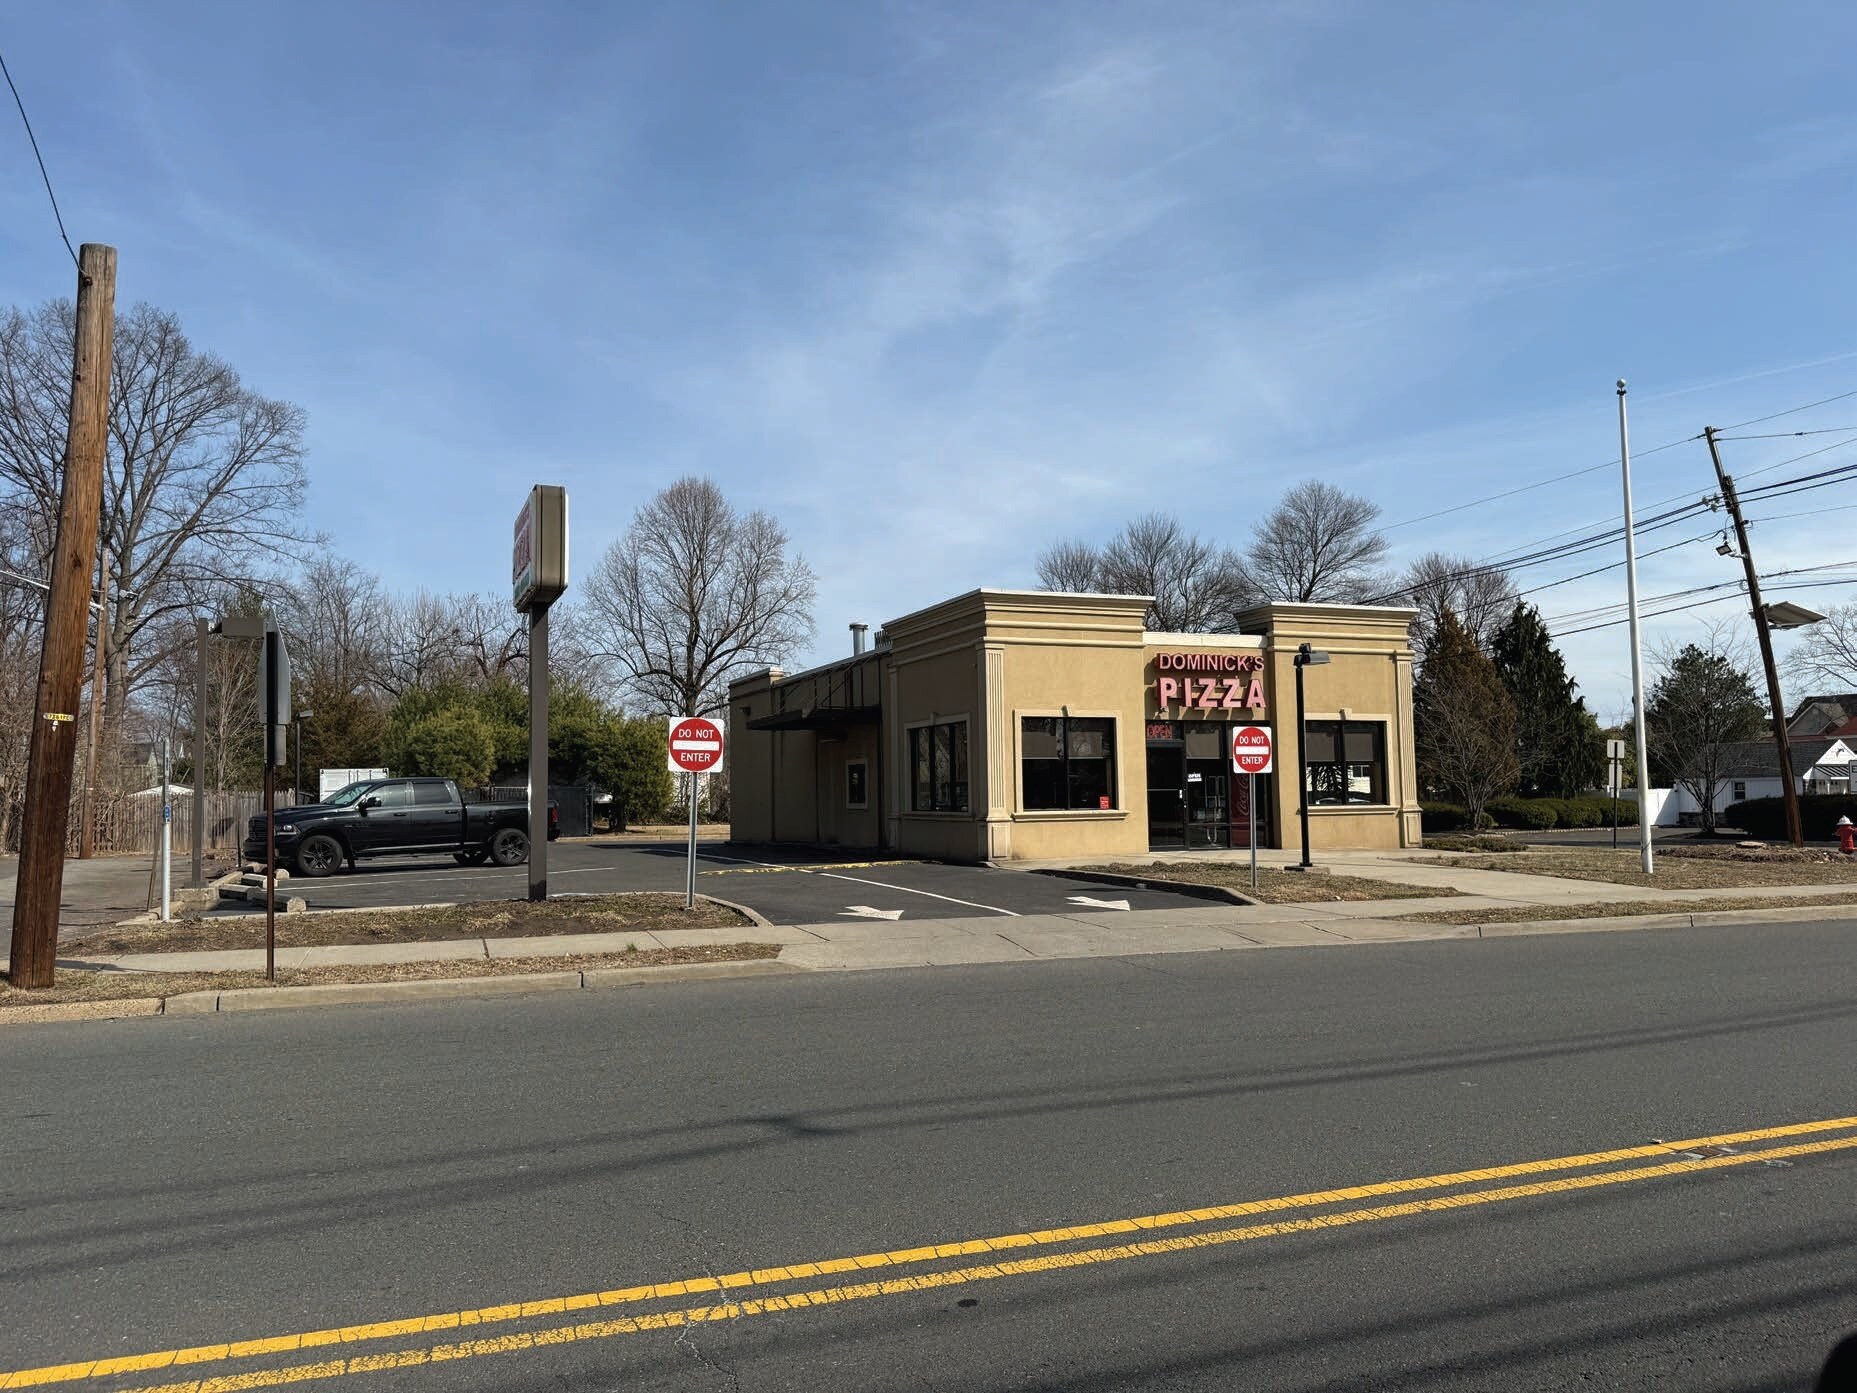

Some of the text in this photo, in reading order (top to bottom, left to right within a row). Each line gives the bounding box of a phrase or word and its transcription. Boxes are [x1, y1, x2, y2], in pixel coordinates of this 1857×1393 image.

[1158, 653, 1265, 671] DOMINICK'S
[1158, 677, 1266, 708] PIZZA
[678, 729, 714, 739] DO NOT
[1147, 724, 1173, 739] OPEN
[1239, 736, 1264, 745] DO NOT
[680, 752, 711, 762] ENTER
[1241, 756, 1263, 765] ENTER
